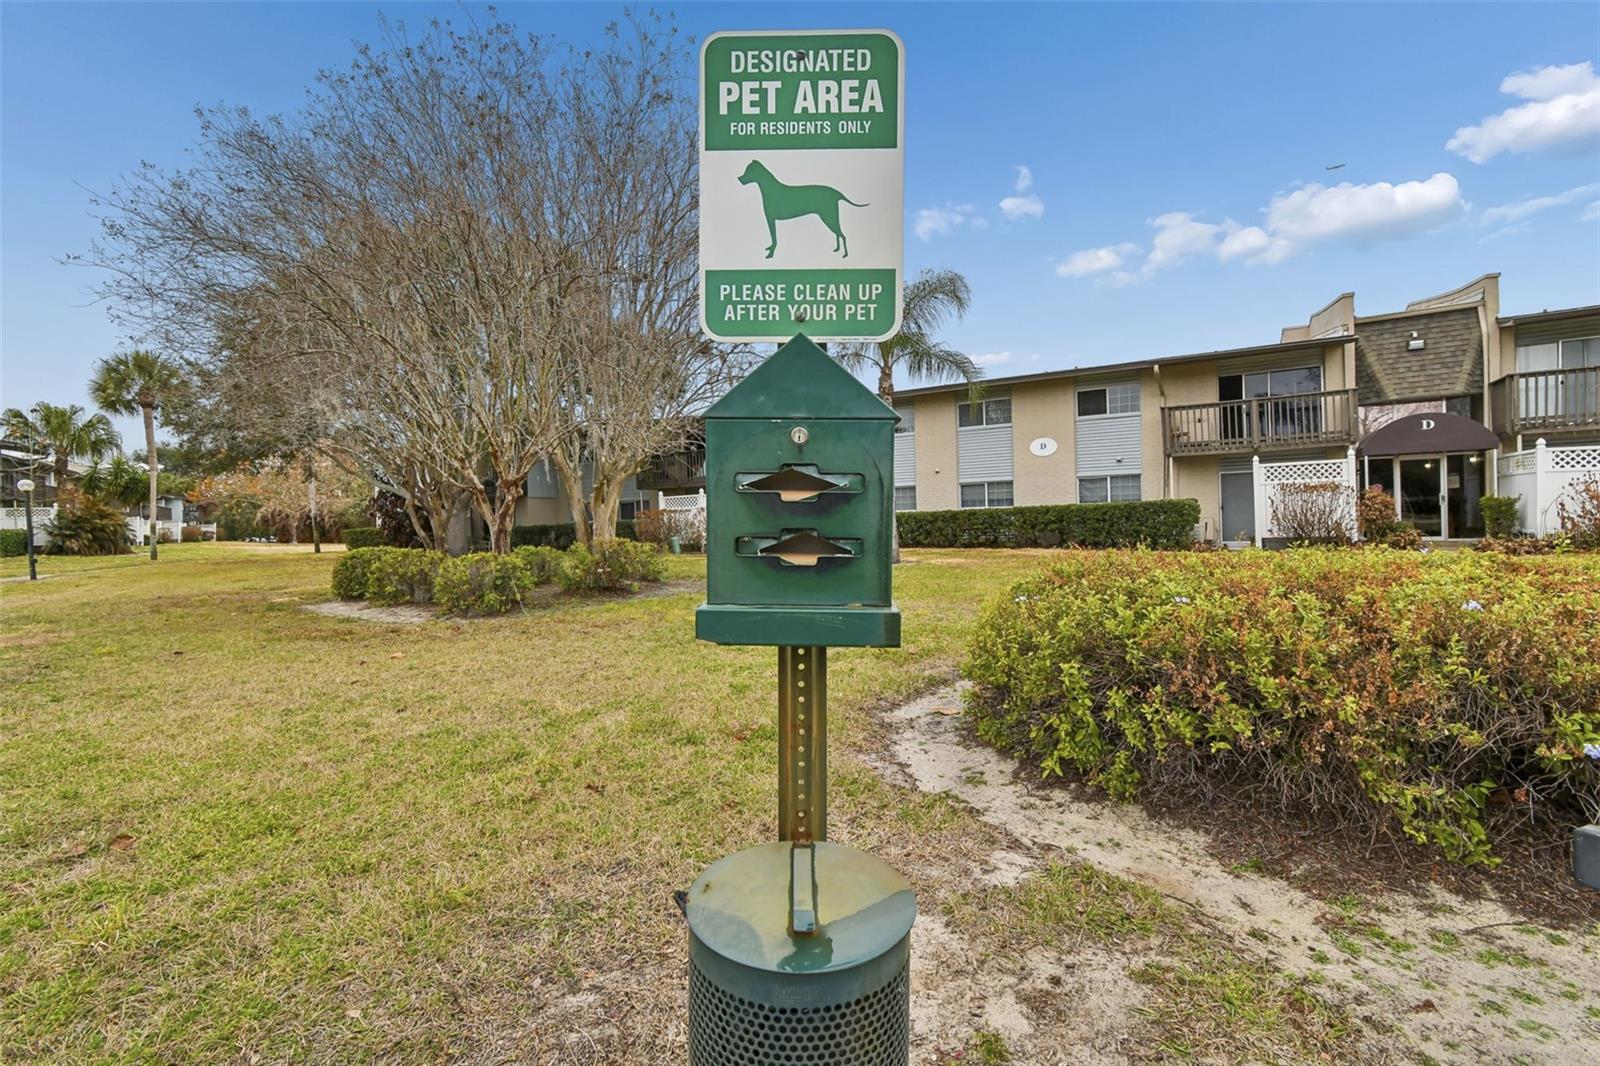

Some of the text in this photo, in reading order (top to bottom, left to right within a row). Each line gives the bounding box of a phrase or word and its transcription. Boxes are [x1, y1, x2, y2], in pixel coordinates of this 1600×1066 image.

[731, 49, 871, 73] DESIGNATED
[719, 79, 884, 115] PET AREA
[730, 120, 871, 135] FOR RESIDENTS ONLY
[720, 283, 882, 301] PLEASE CLEAN UP
[724, 303, 878, 321] AFTER YOUR PET
[1420, 419, 1436, 431] D
